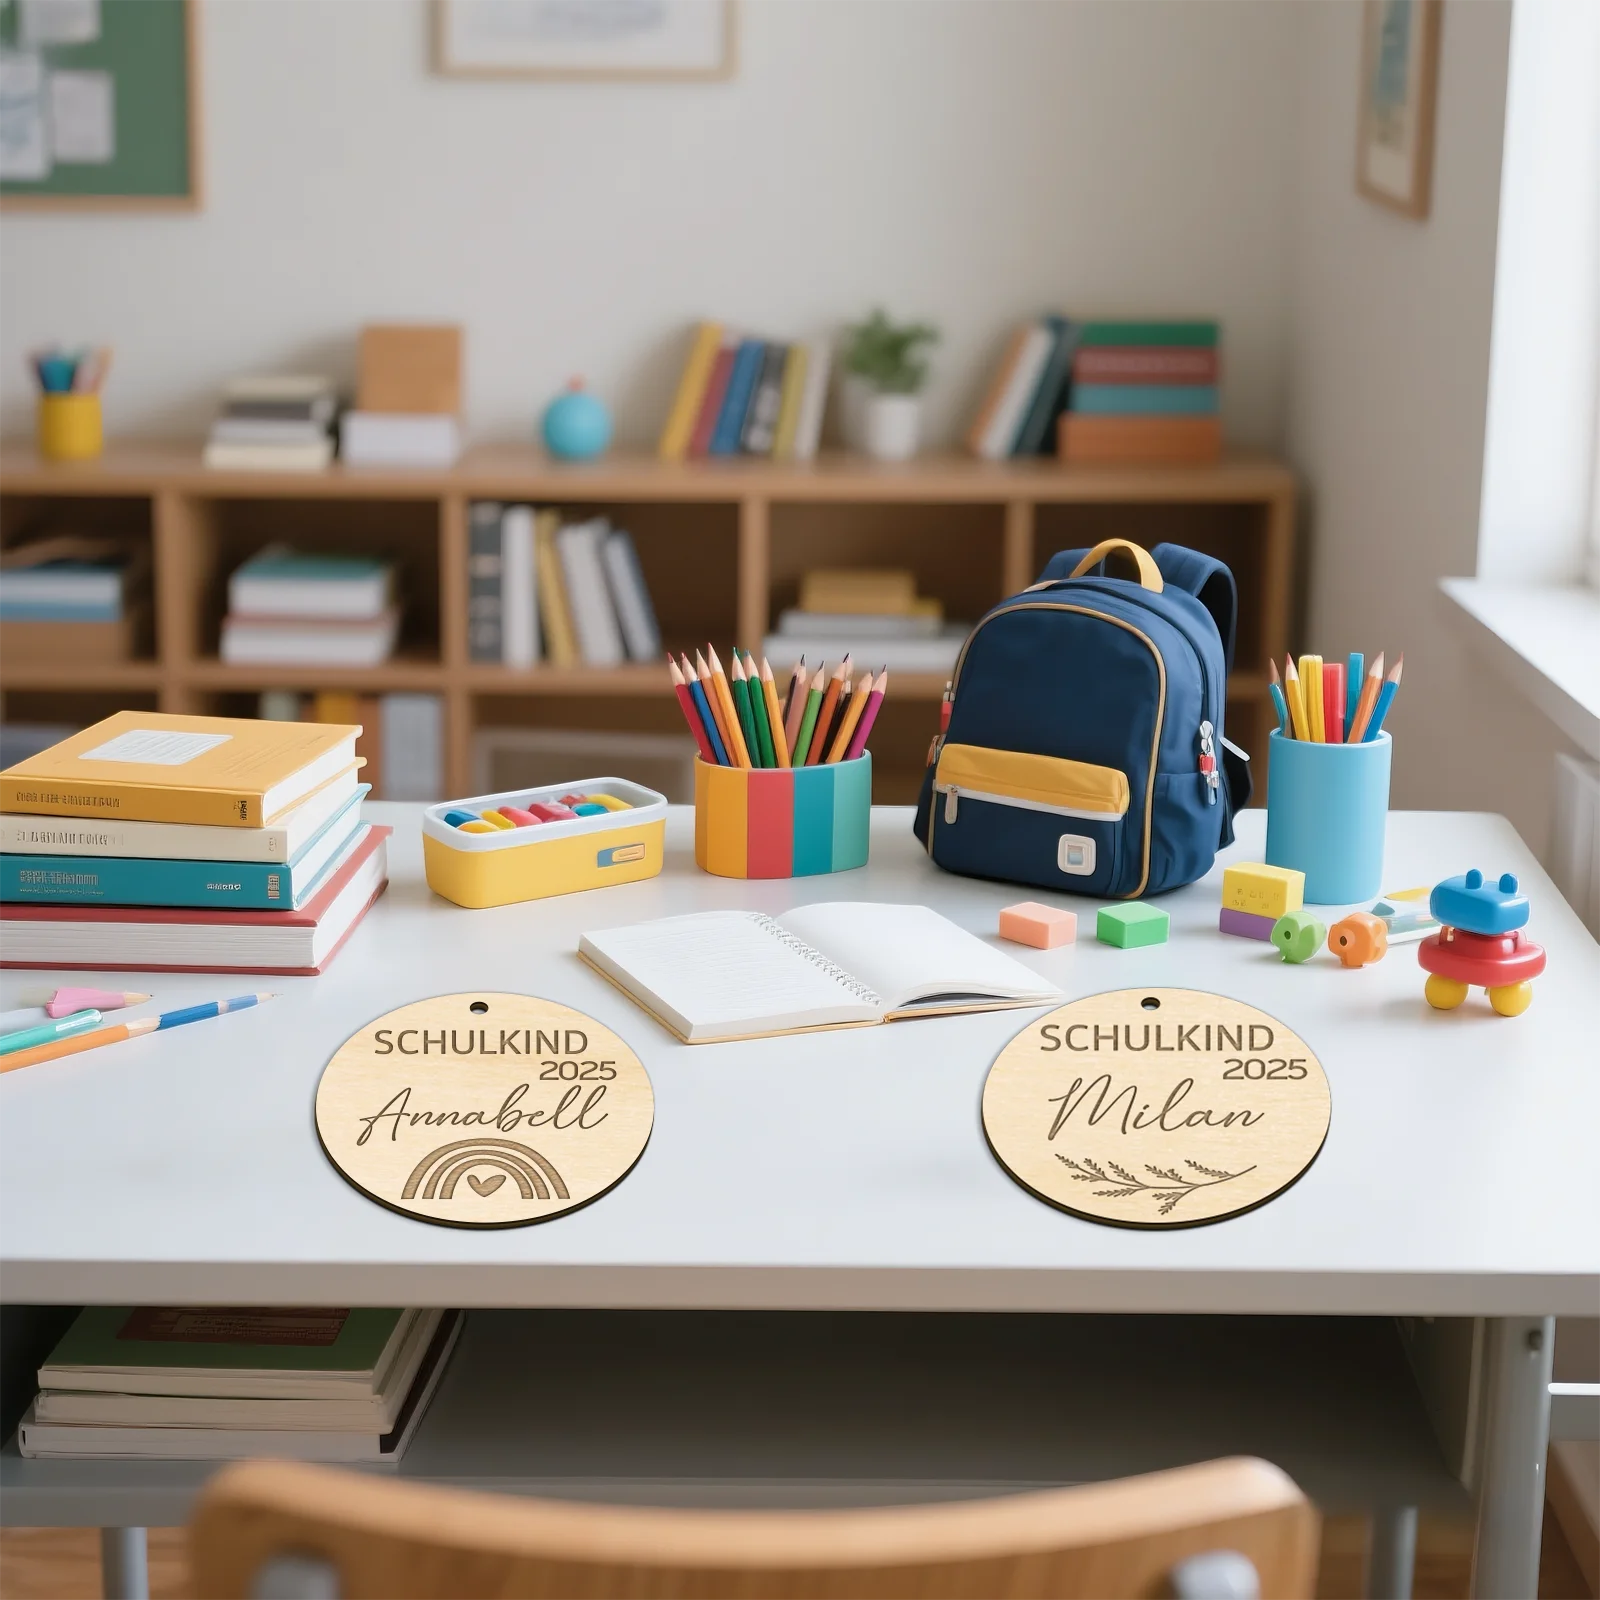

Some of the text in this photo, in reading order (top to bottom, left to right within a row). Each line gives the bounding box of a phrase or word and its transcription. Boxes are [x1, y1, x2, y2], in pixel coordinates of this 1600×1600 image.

[374, 1029, 588, 1055] SCHULKIND
[1040, 1024, 1274, 1052] SCHULKIND
[539, 1060, 617, 1081] 2025
[1222, 1058, 1308, 1080] 2025
[356, 1083, 610, 1146] Annabell
[1047, 1073, 1265, 1141] Milan
